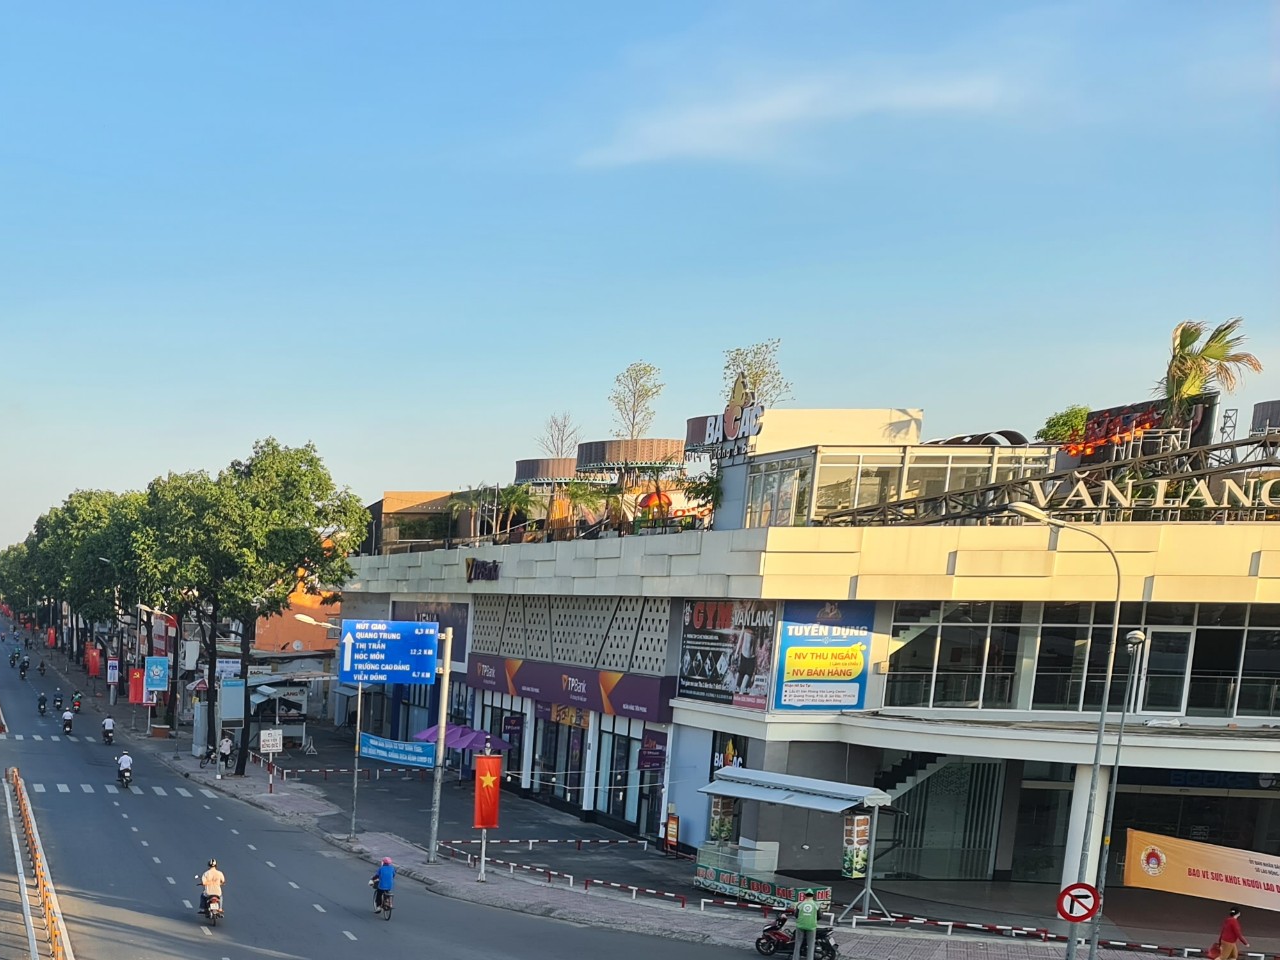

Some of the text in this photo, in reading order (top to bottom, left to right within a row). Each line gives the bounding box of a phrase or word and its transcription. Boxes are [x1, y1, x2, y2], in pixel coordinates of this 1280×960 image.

[1029, 471, 1138, 508] VĂN
[693, 602, 733, 629] GYM
[751, 611, 773, 627] LANG
[379, 632, 401, 640] TRUNG
[832, 626, 868, 639] DỤNG
[794, 652, 808, 660] NV
[810, 652, 828, 660] THU
[568, 678, 587, 693] TPBank
[1263, 881, 1274, 892] LAO
